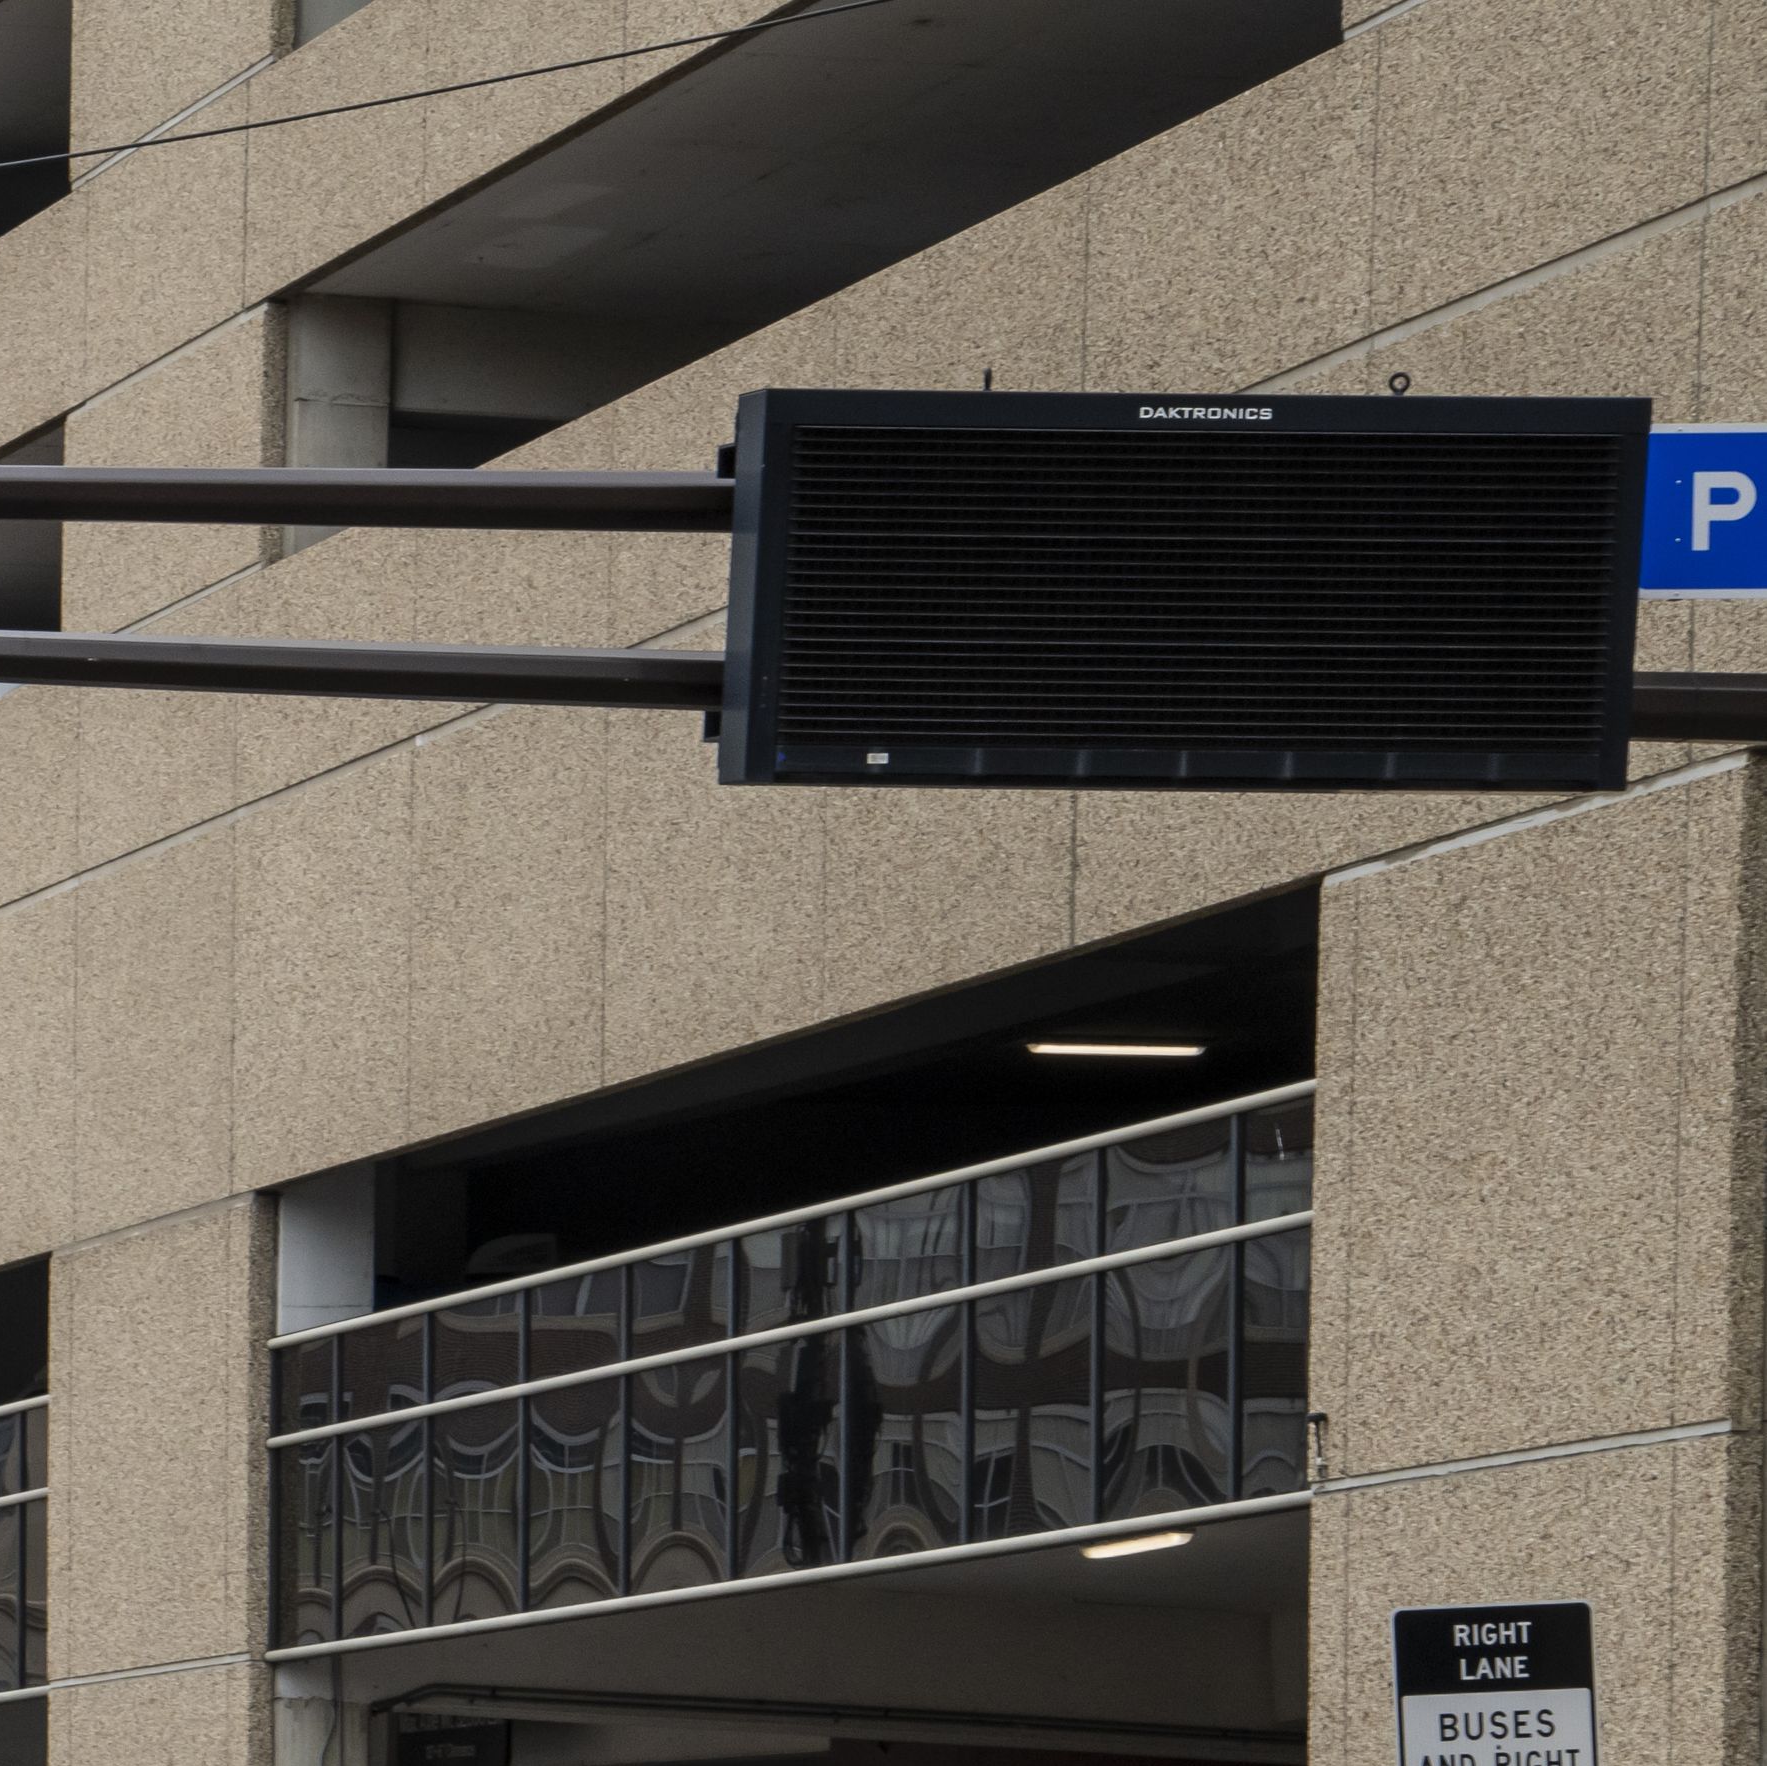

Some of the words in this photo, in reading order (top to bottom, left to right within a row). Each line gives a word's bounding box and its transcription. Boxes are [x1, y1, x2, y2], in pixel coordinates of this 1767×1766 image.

[1139, 407, 1273, 421] DAKTRONICS
[1692, 471, 1757, 551] P
[1454, 1621, 1532, 1647] RIGHT
[1460, 1656, 1530, 1681] LANE
[1439, 1709, 1556, 1742] BUSES
